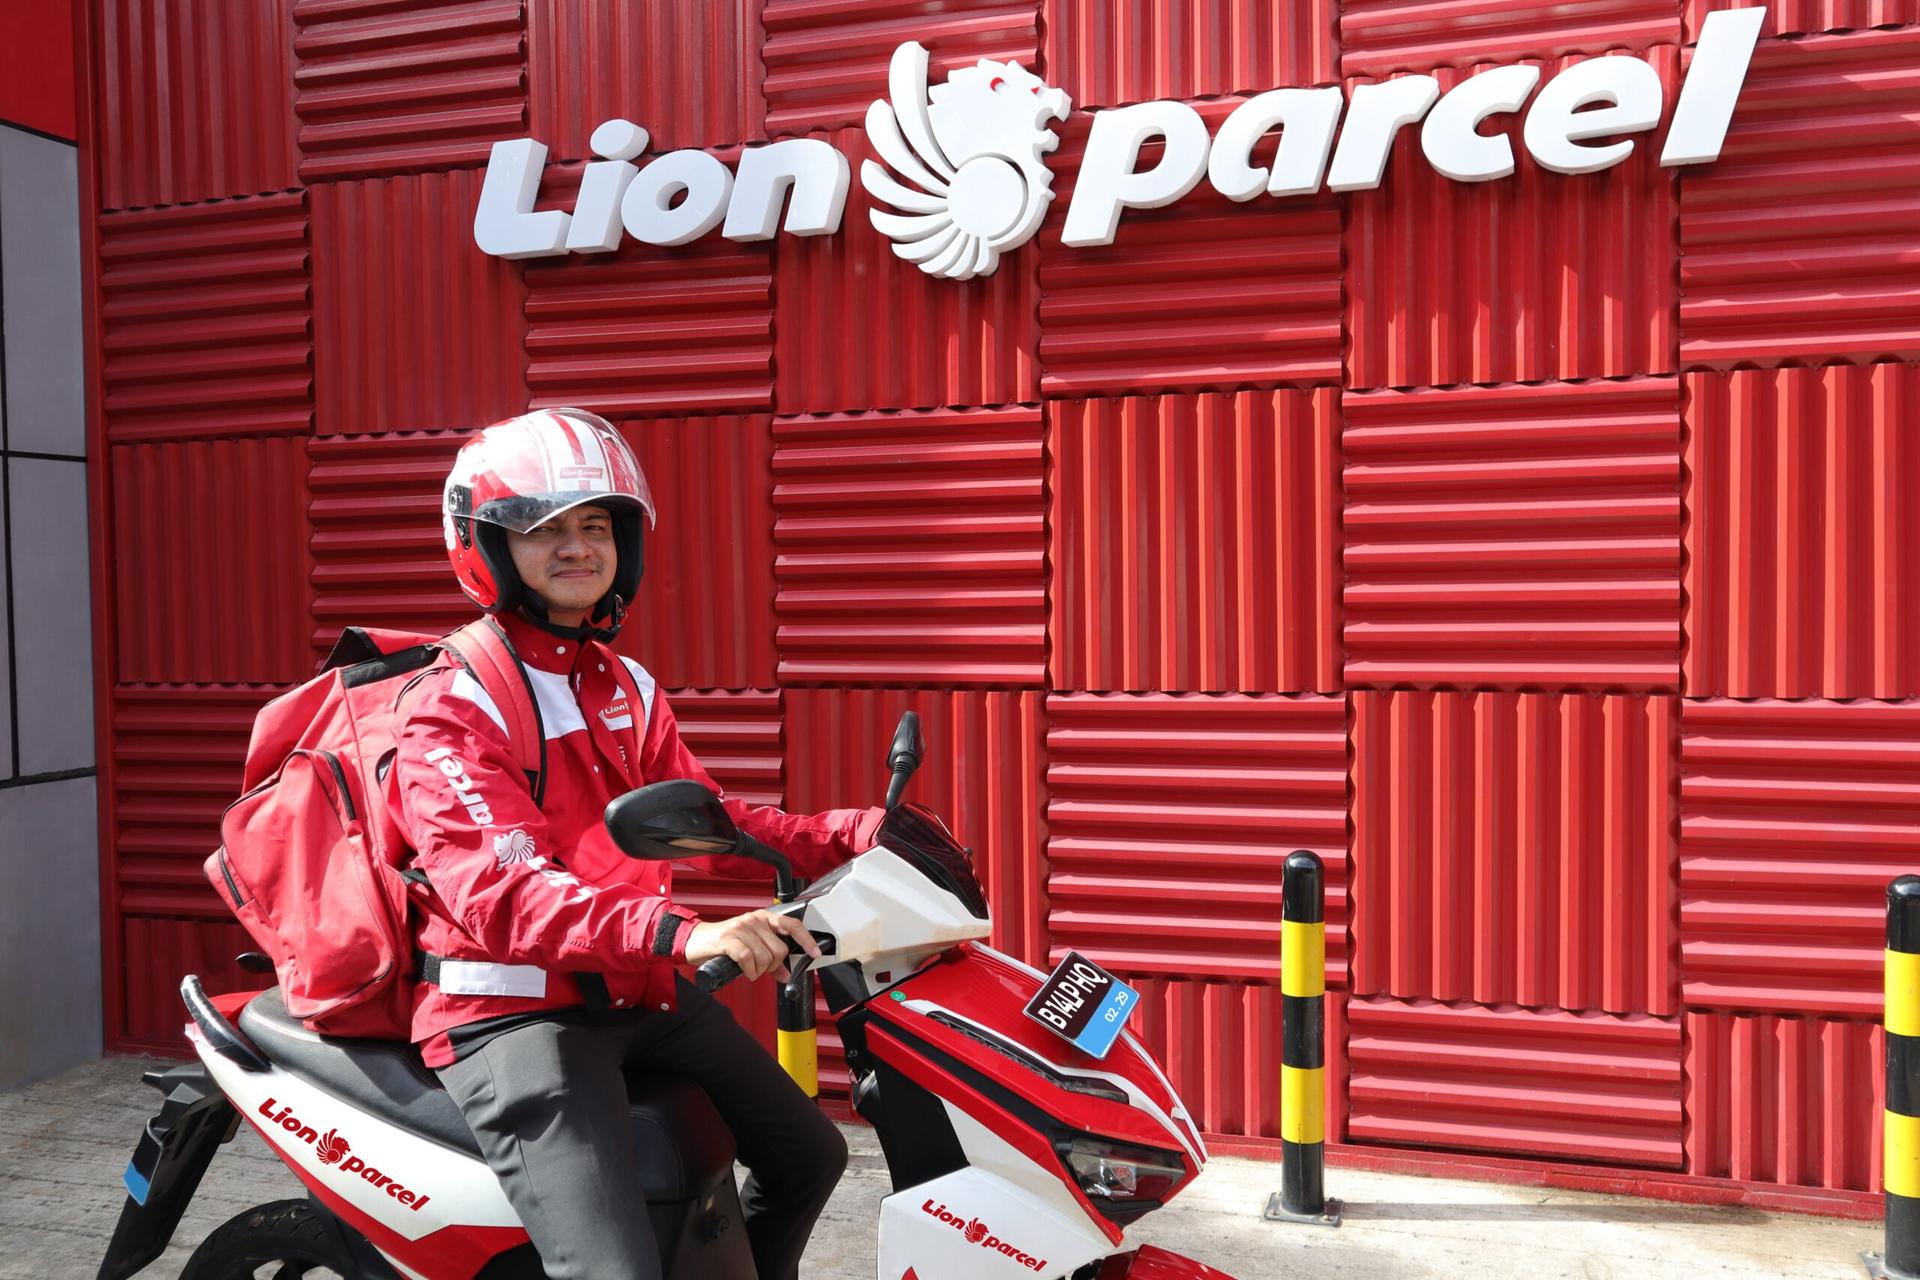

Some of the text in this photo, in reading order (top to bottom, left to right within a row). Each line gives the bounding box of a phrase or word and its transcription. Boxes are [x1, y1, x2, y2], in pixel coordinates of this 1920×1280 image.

[474, 6, 1766, 259] Lion parcel
[604, 703, 625, 715] Lion
[424, 748, 494, 826] arcel
[258, 1097, 430, 1211] Lion parcel
[921, 1199, 1047, 1272] Lion parcel
